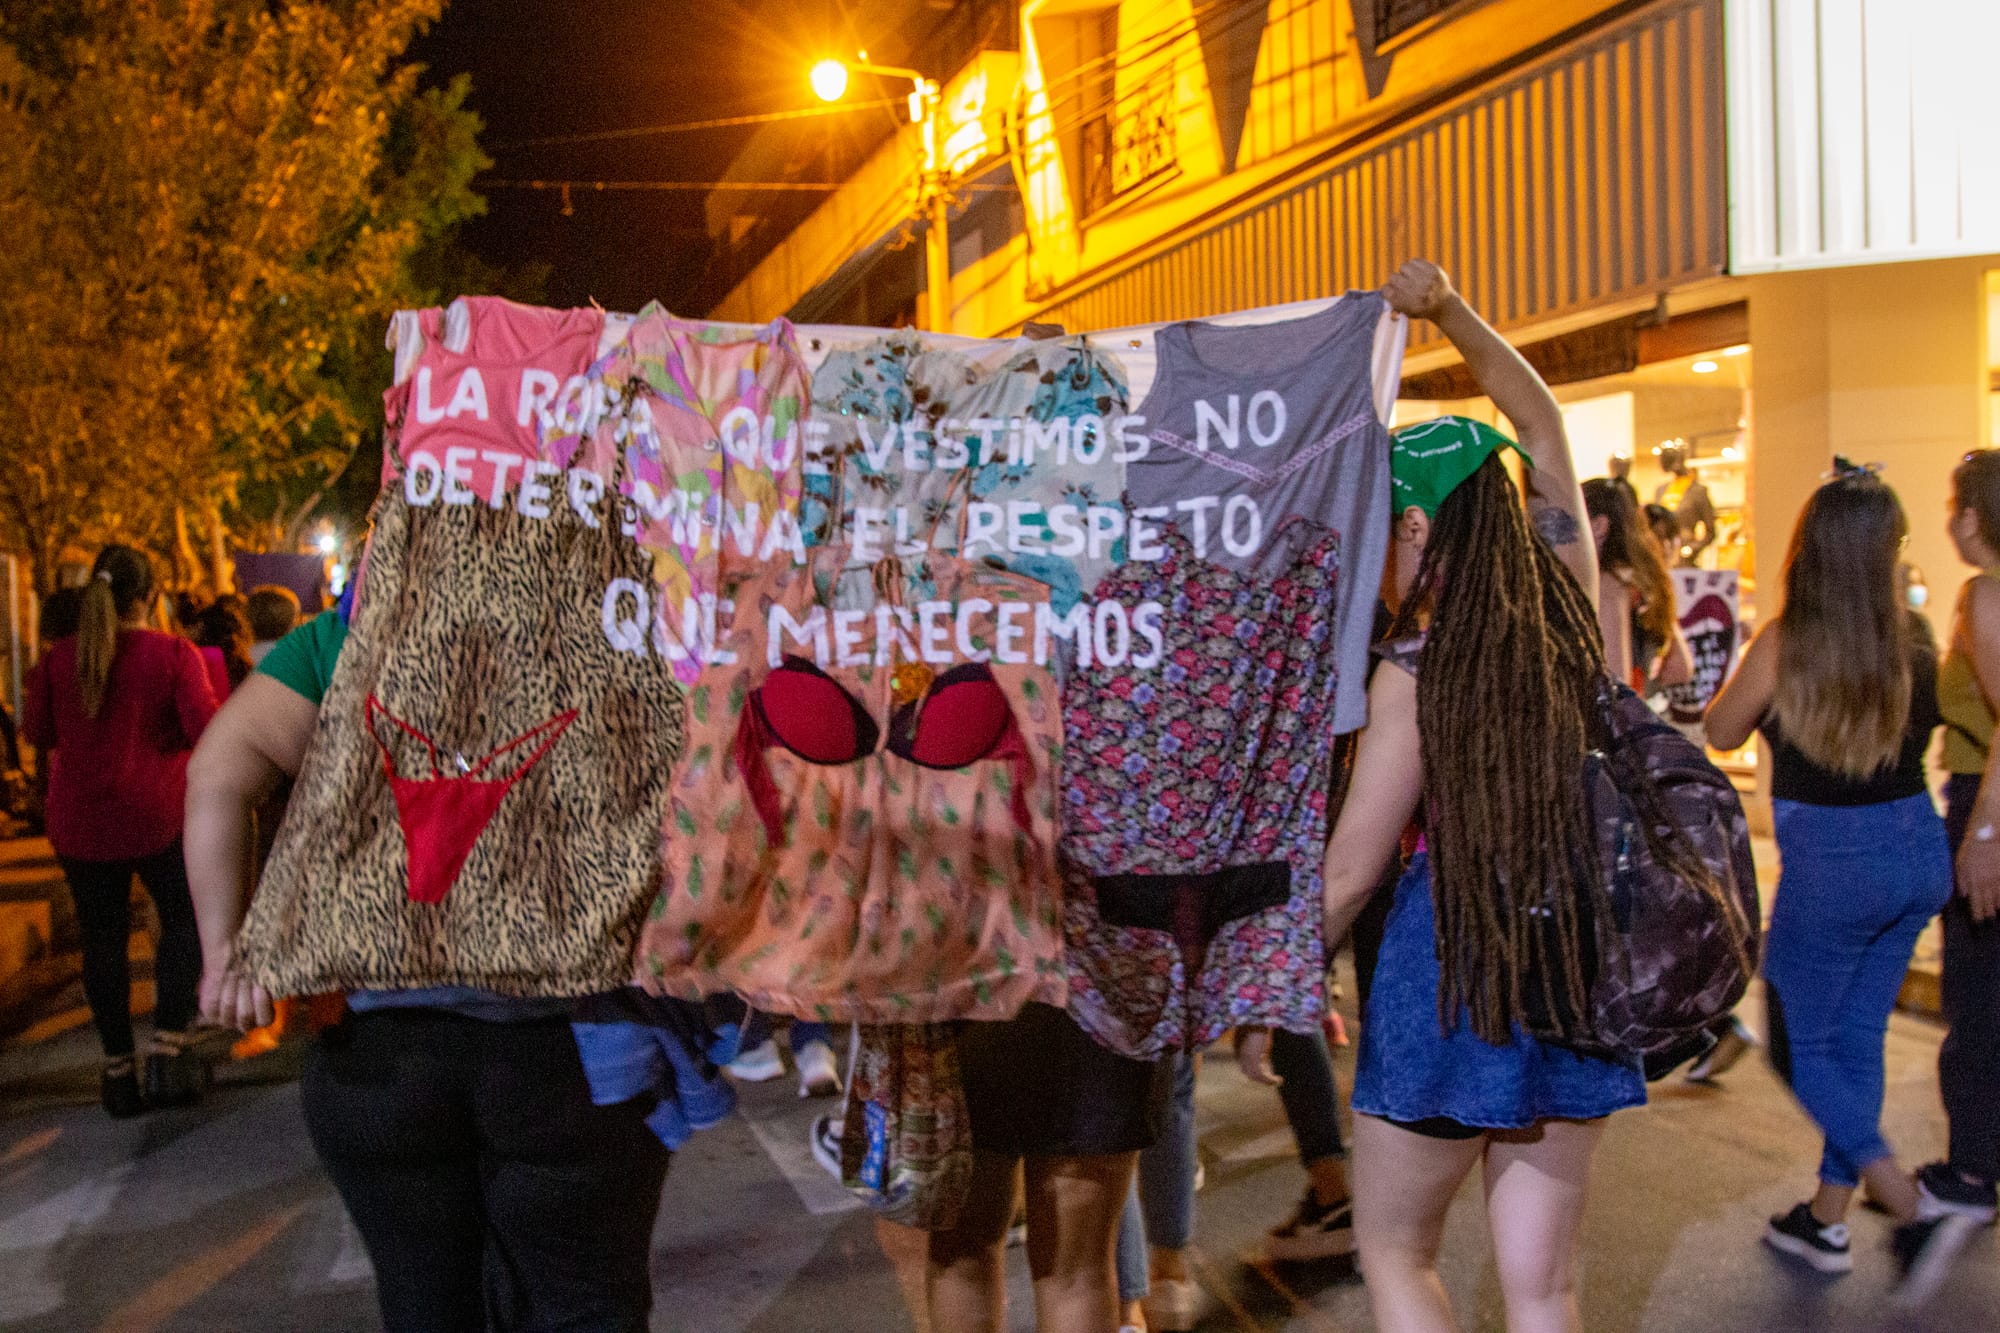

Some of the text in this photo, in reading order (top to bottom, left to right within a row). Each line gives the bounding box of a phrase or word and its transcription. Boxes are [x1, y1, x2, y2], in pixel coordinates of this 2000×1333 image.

[416, 367, 1287, 474] LA ROPA QUE VESTIMOS NO
[404, 446, 1262, 565] DETERMINA EL RESPETO
[602, 577, 1164, 669] QUE MERECEMOS
